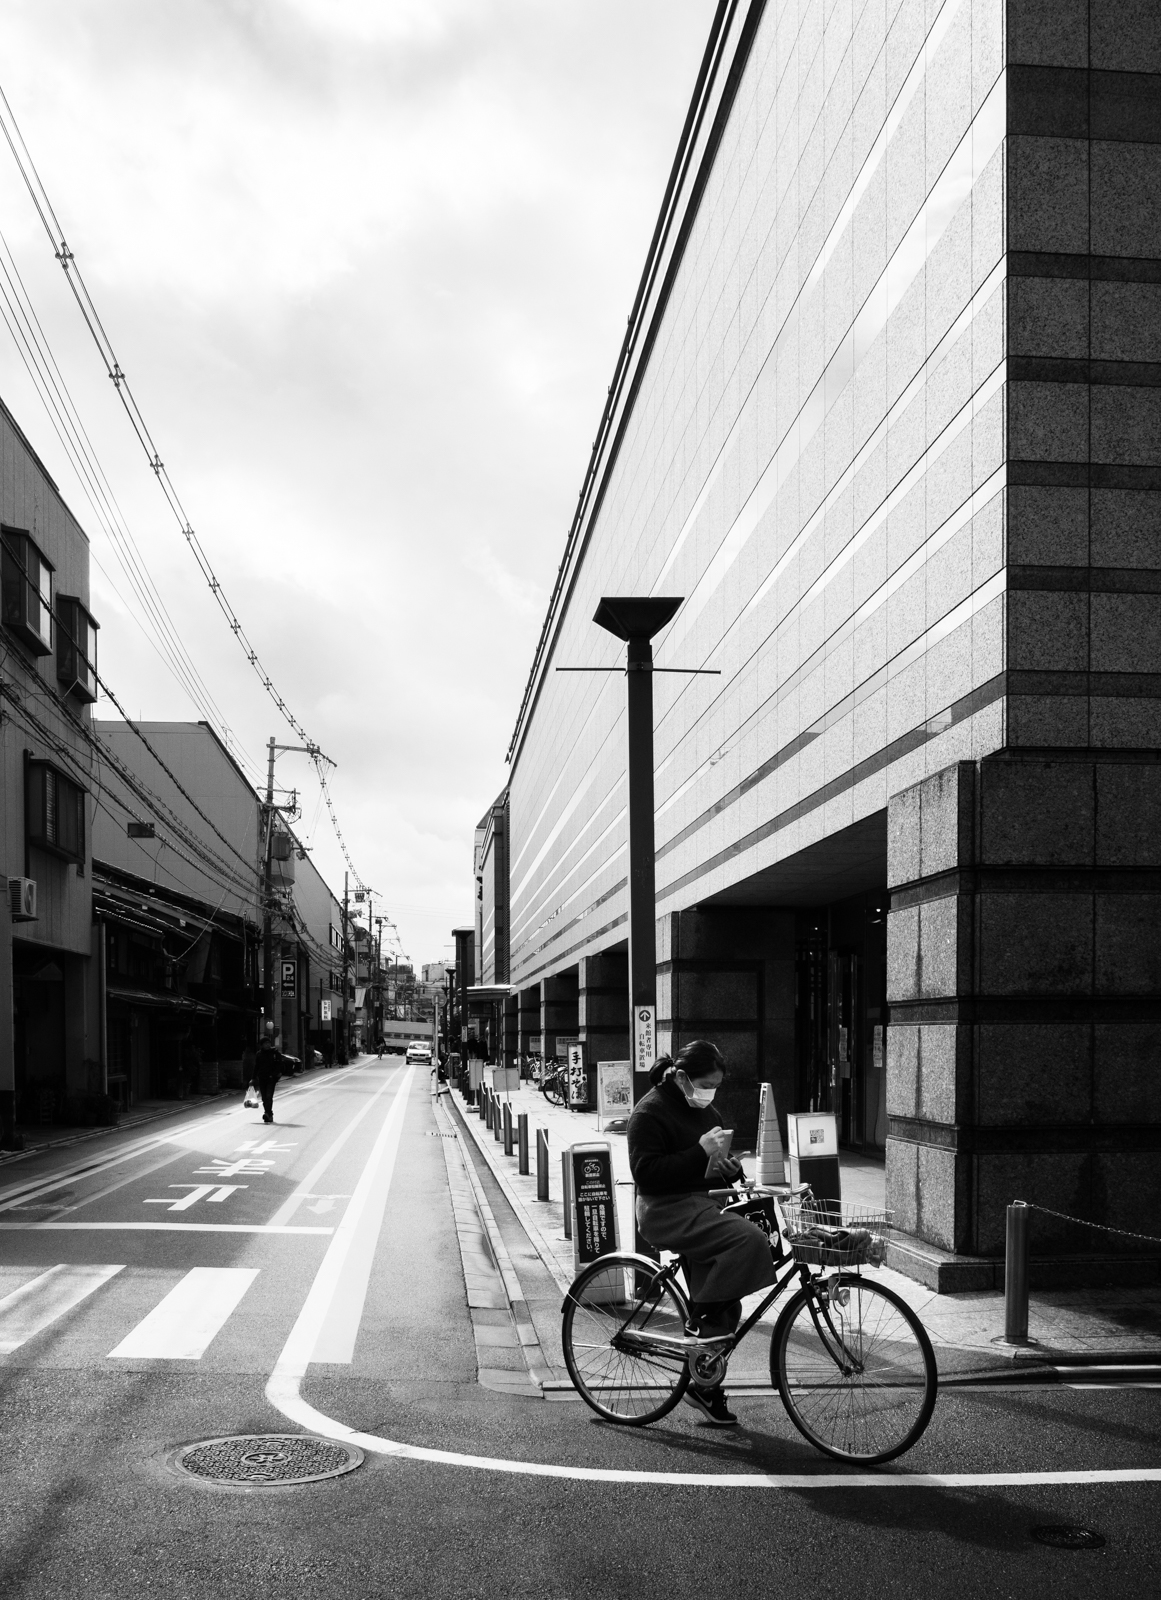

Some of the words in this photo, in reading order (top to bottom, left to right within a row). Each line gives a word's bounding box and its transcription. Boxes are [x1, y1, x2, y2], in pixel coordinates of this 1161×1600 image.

[283, 964, 294, 981] P
[638, 1033, 646, 1068] 自転車置場
